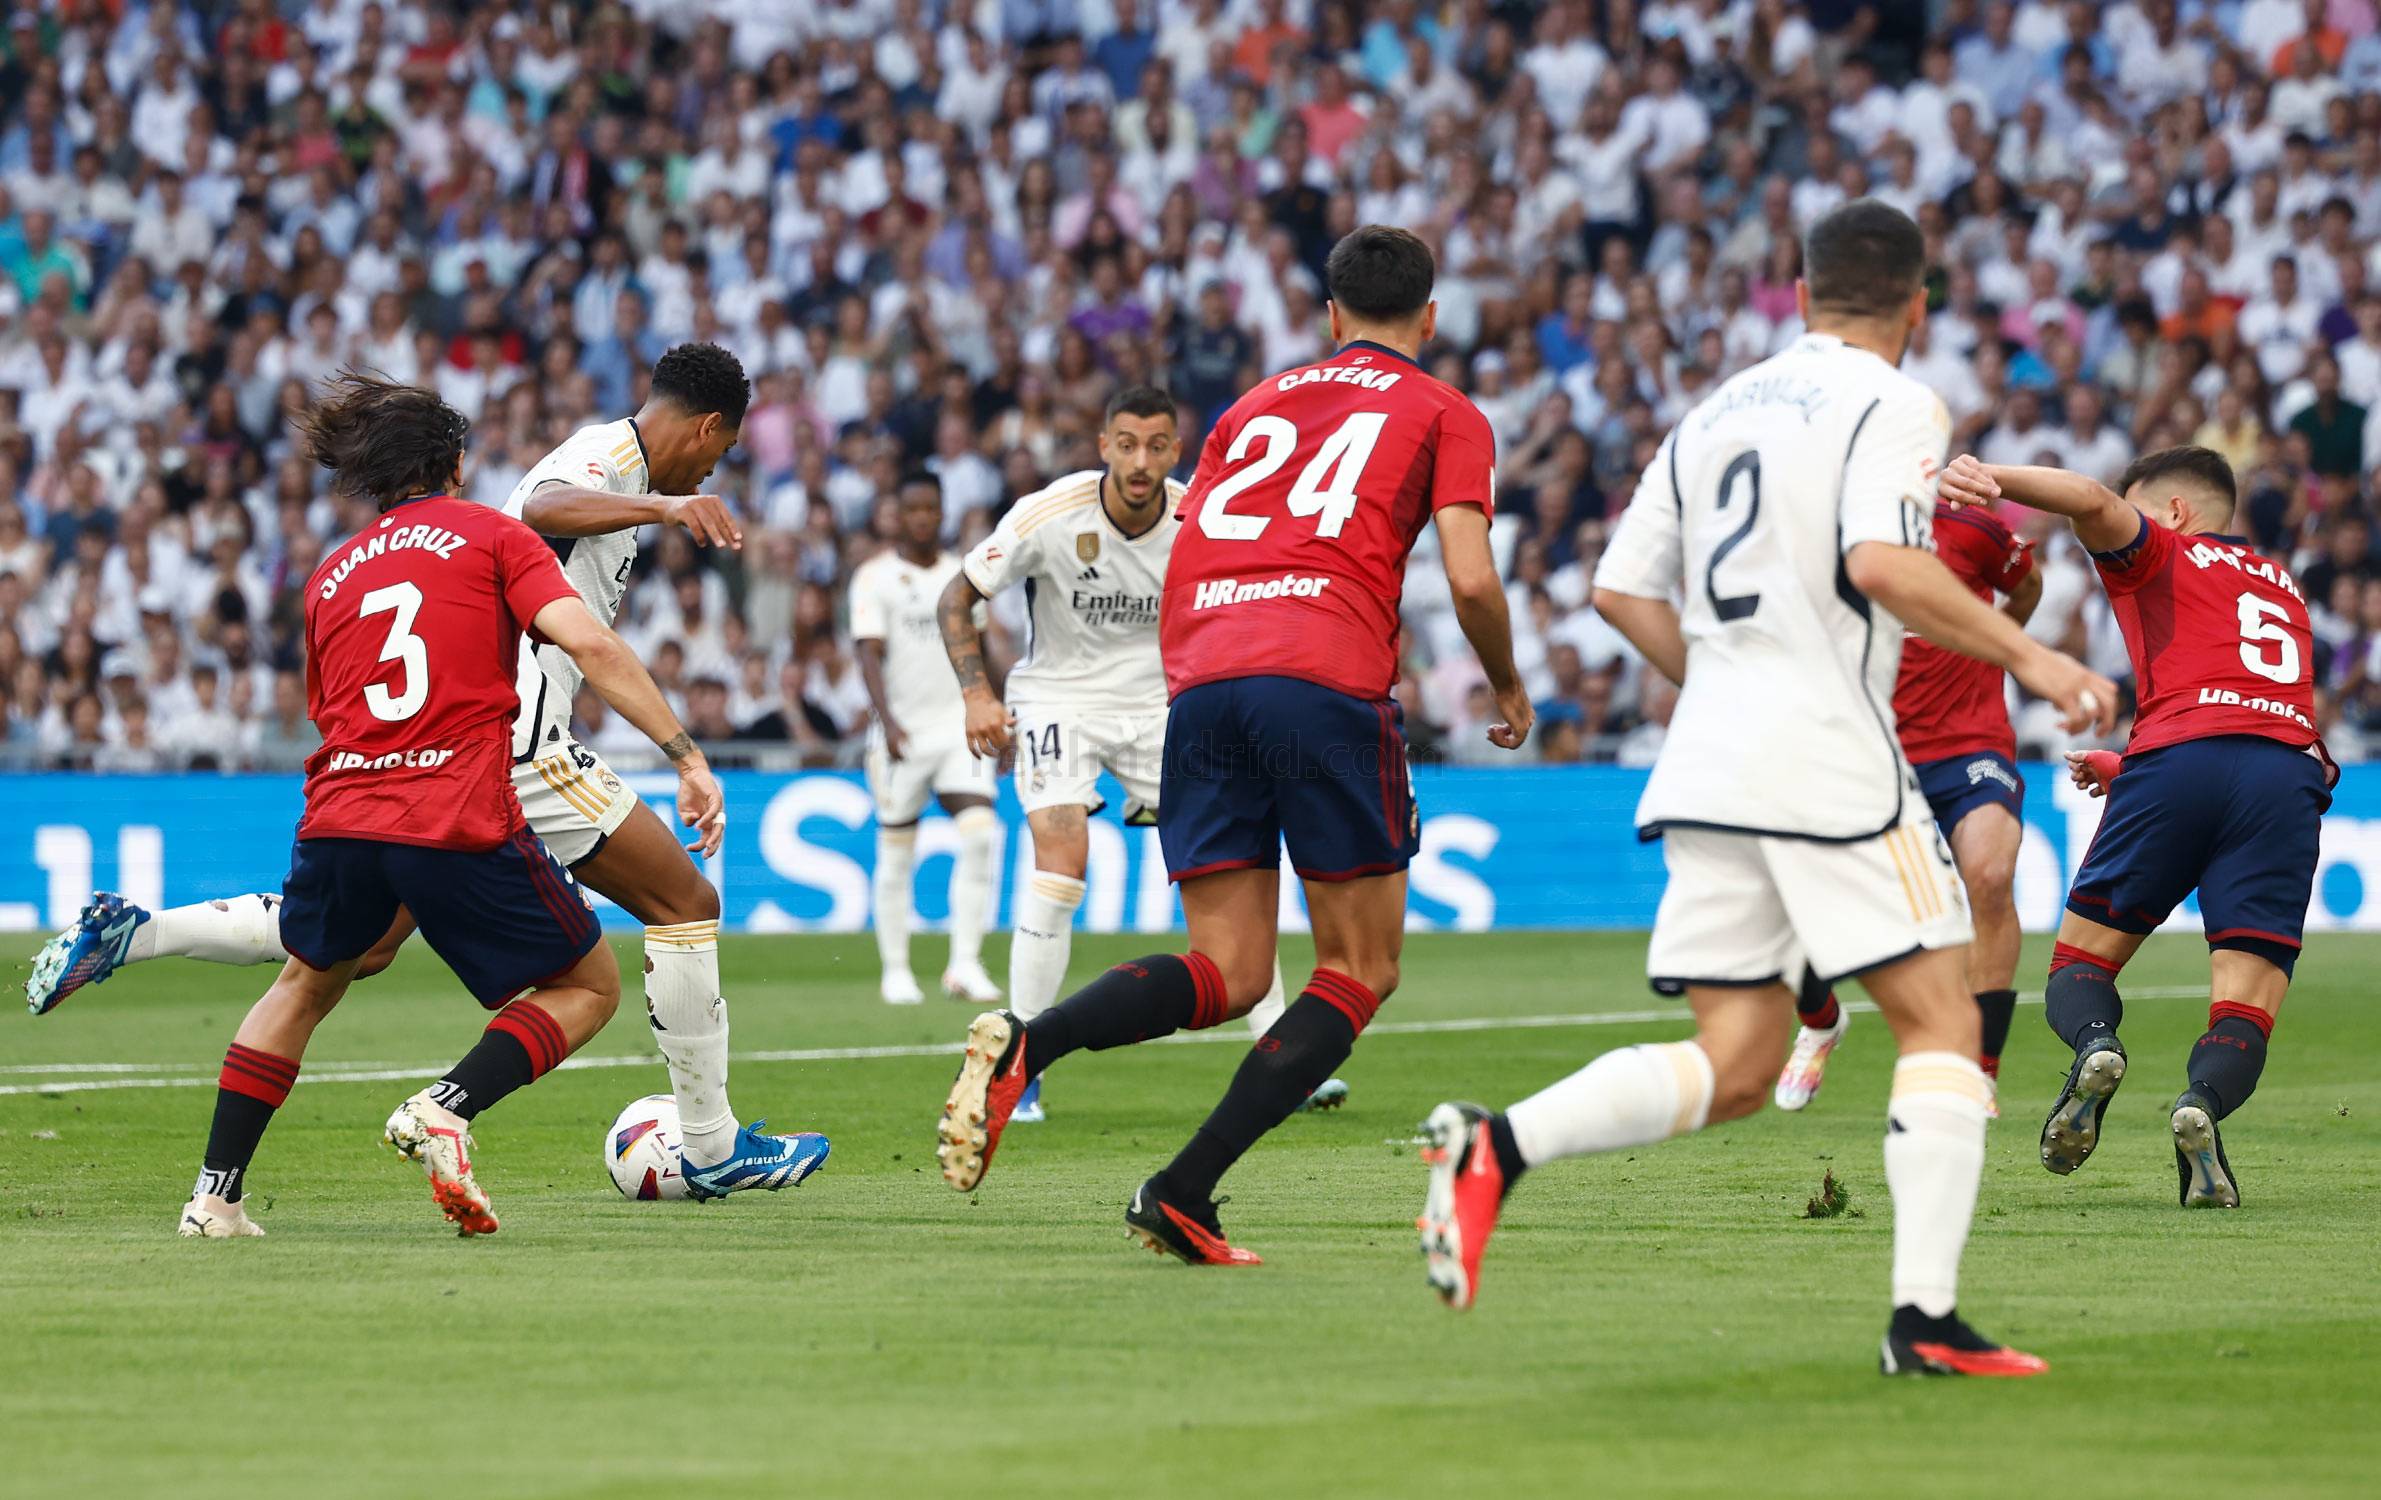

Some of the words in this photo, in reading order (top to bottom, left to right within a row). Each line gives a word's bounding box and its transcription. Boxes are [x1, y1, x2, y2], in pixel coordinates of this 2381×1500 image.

[1277, 366, 1403, 392] CATENA
[1198, 411, 1390, 541] 24
[320, 533, 388, 600] JUAN
[389, 524, 468, 560] CRUZ
[1705, 449, 1761, 623] 2
[1072, 590, 1160, 611] Emirat
[1193, 574, 1330, 611] HRmotor
[359, 580, 430, 722] 3
[2236, 591, 2300, 684] 5
[1026, 723, 1062, 768] 14
